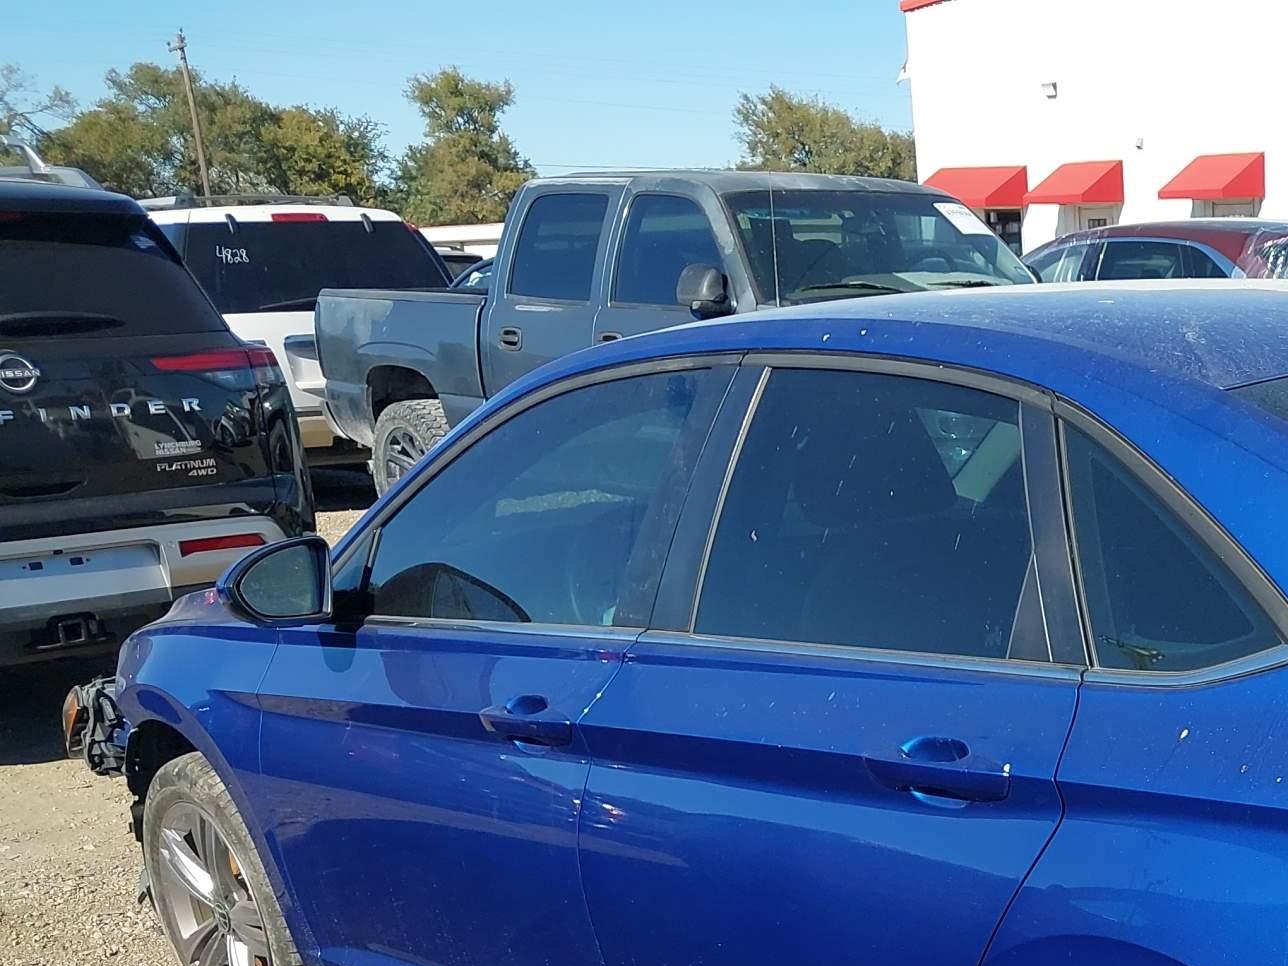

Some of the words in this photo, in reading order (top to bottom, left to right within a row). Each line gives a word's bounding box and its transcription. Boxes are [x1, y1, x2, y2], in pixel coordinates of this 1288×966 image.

[215, 245, 250, 264] 4828
[156, 458, 217, 472] PLATINUM
[188, 468, 217, 477] 4WD
